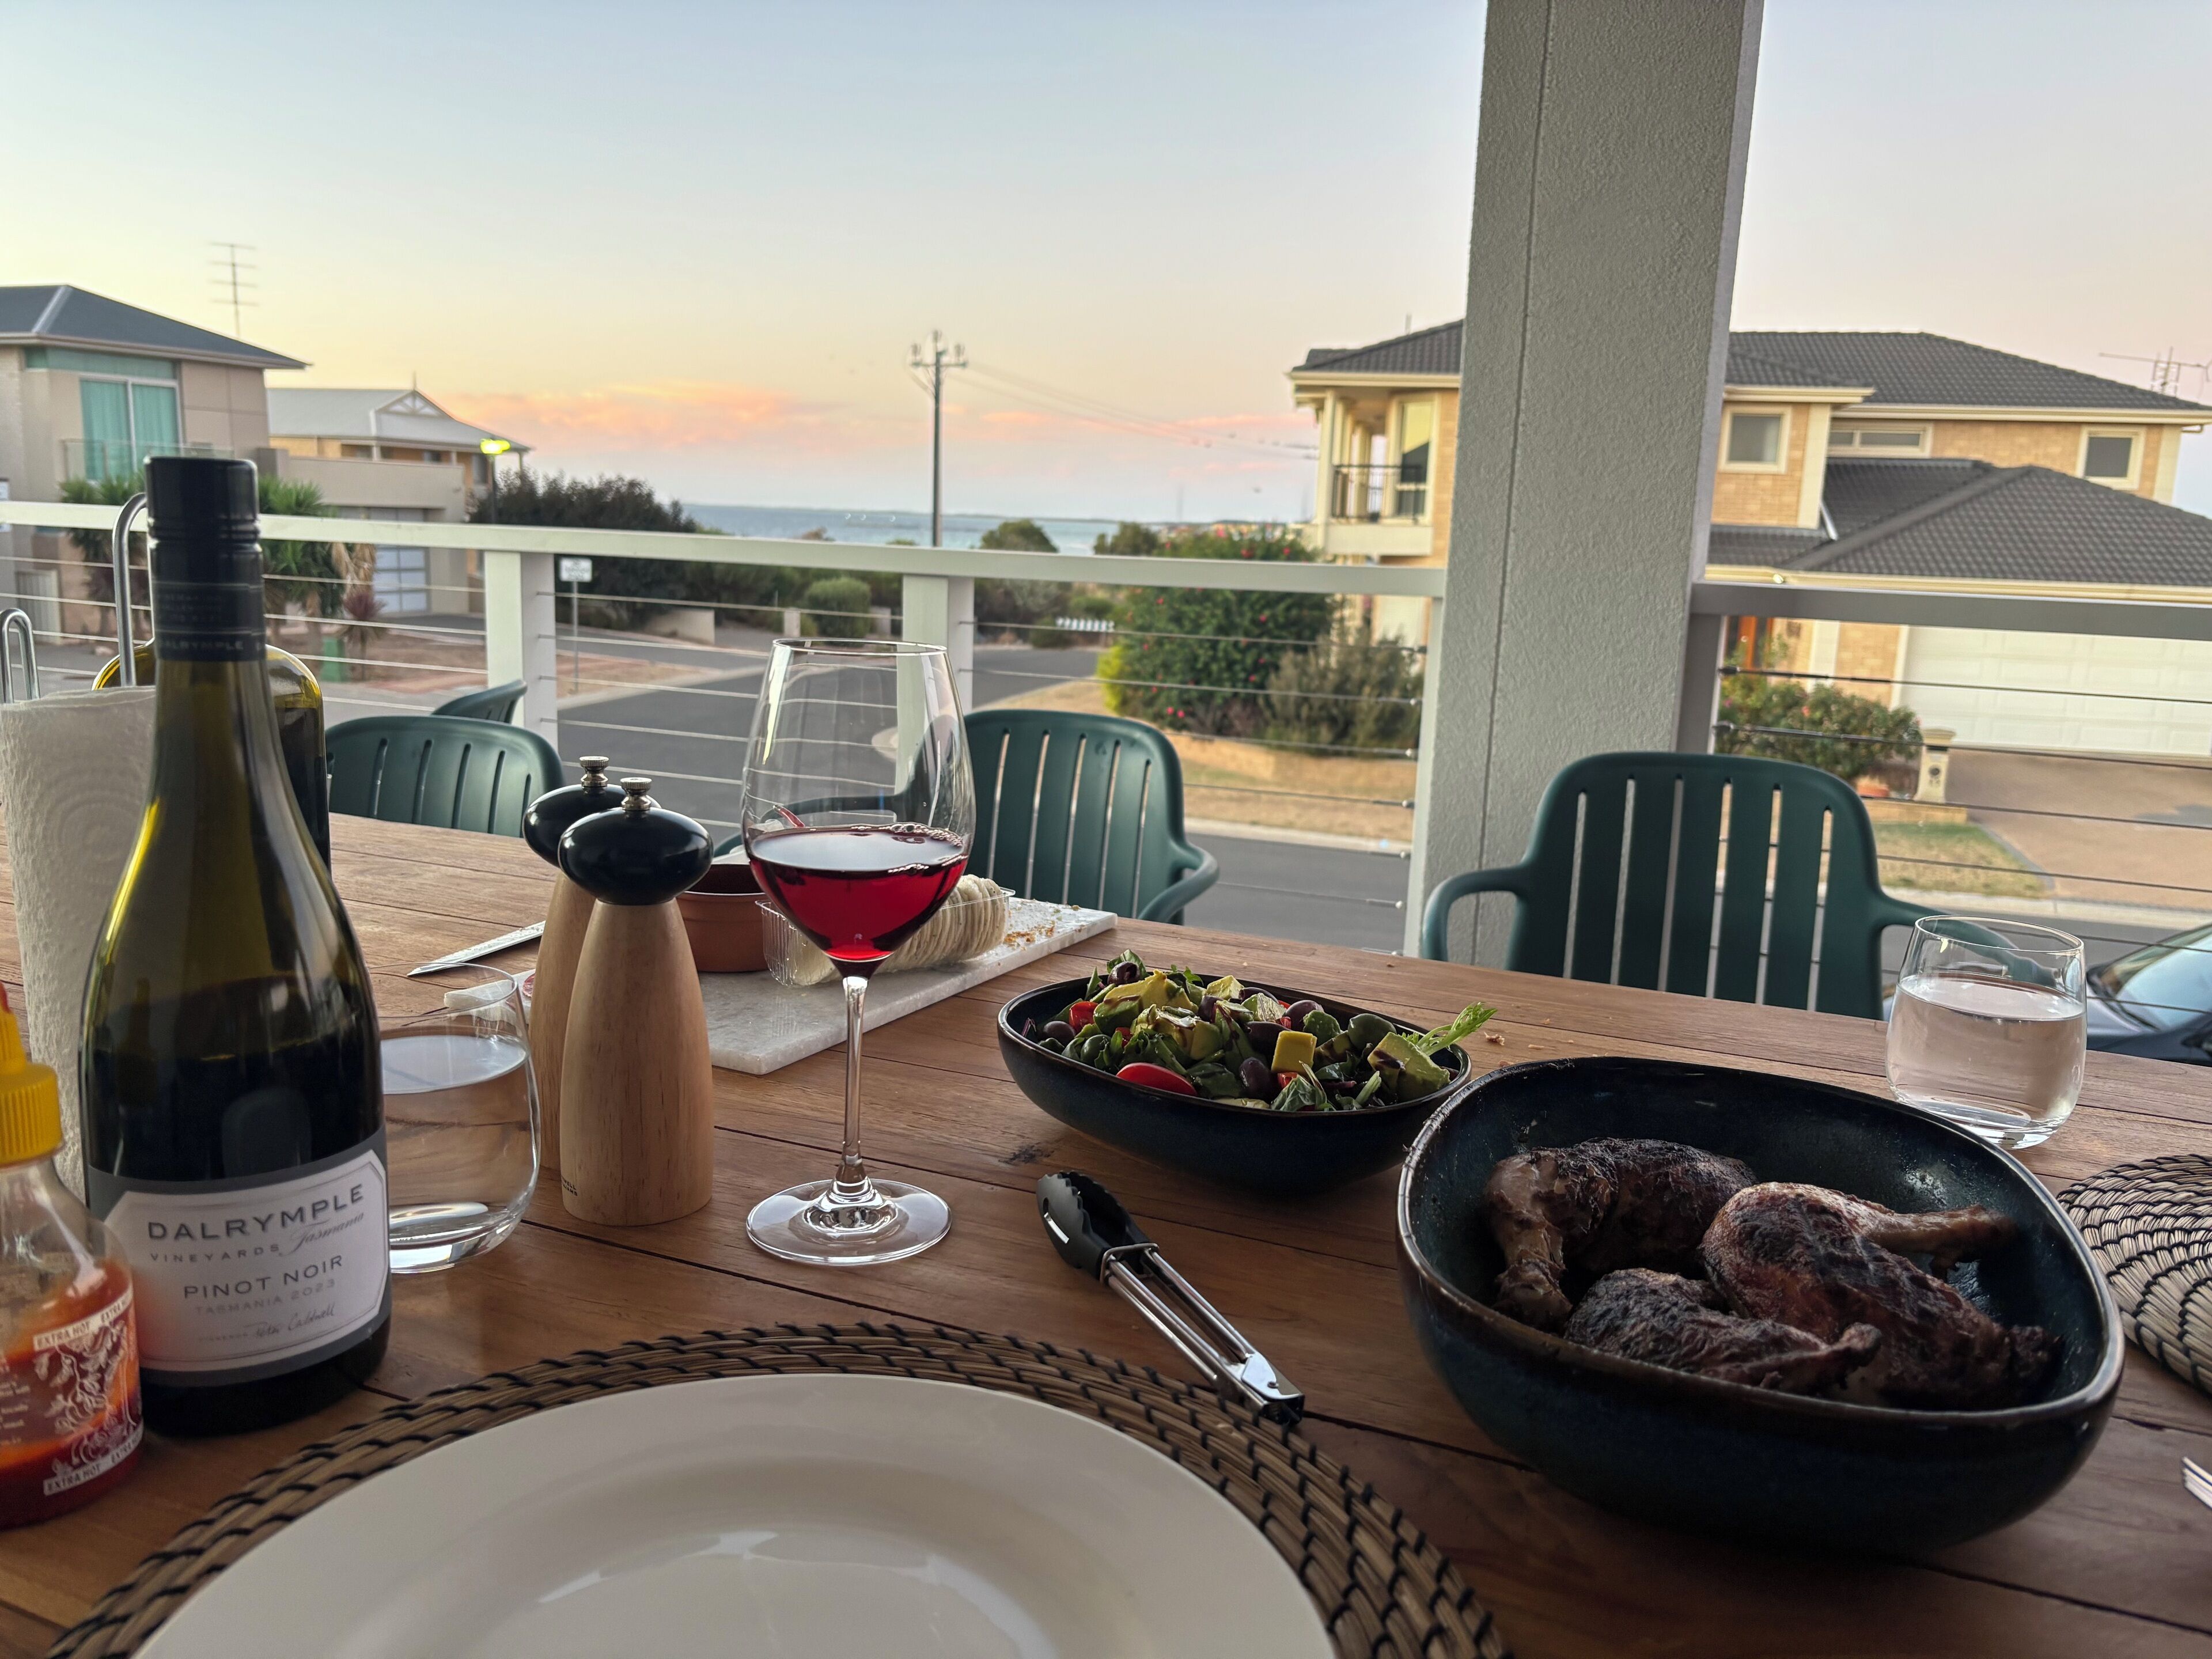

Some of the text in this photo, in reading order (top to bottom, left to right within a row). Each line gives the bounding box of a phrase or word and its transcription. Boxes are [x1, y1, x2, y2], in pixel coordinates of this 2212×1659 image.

[147, 1183, 364, 1241] DALRYMPLE
[150, 1244, 280, 1263] VINEYARDS
[184, 1255, 343, 1299] PINOT NOIR
[196, 1296, 283, 1314] TASMANIA
[37, 1330, 70, 1348] EXTRA
[47, 1473, 81, 1492] EXTRA
